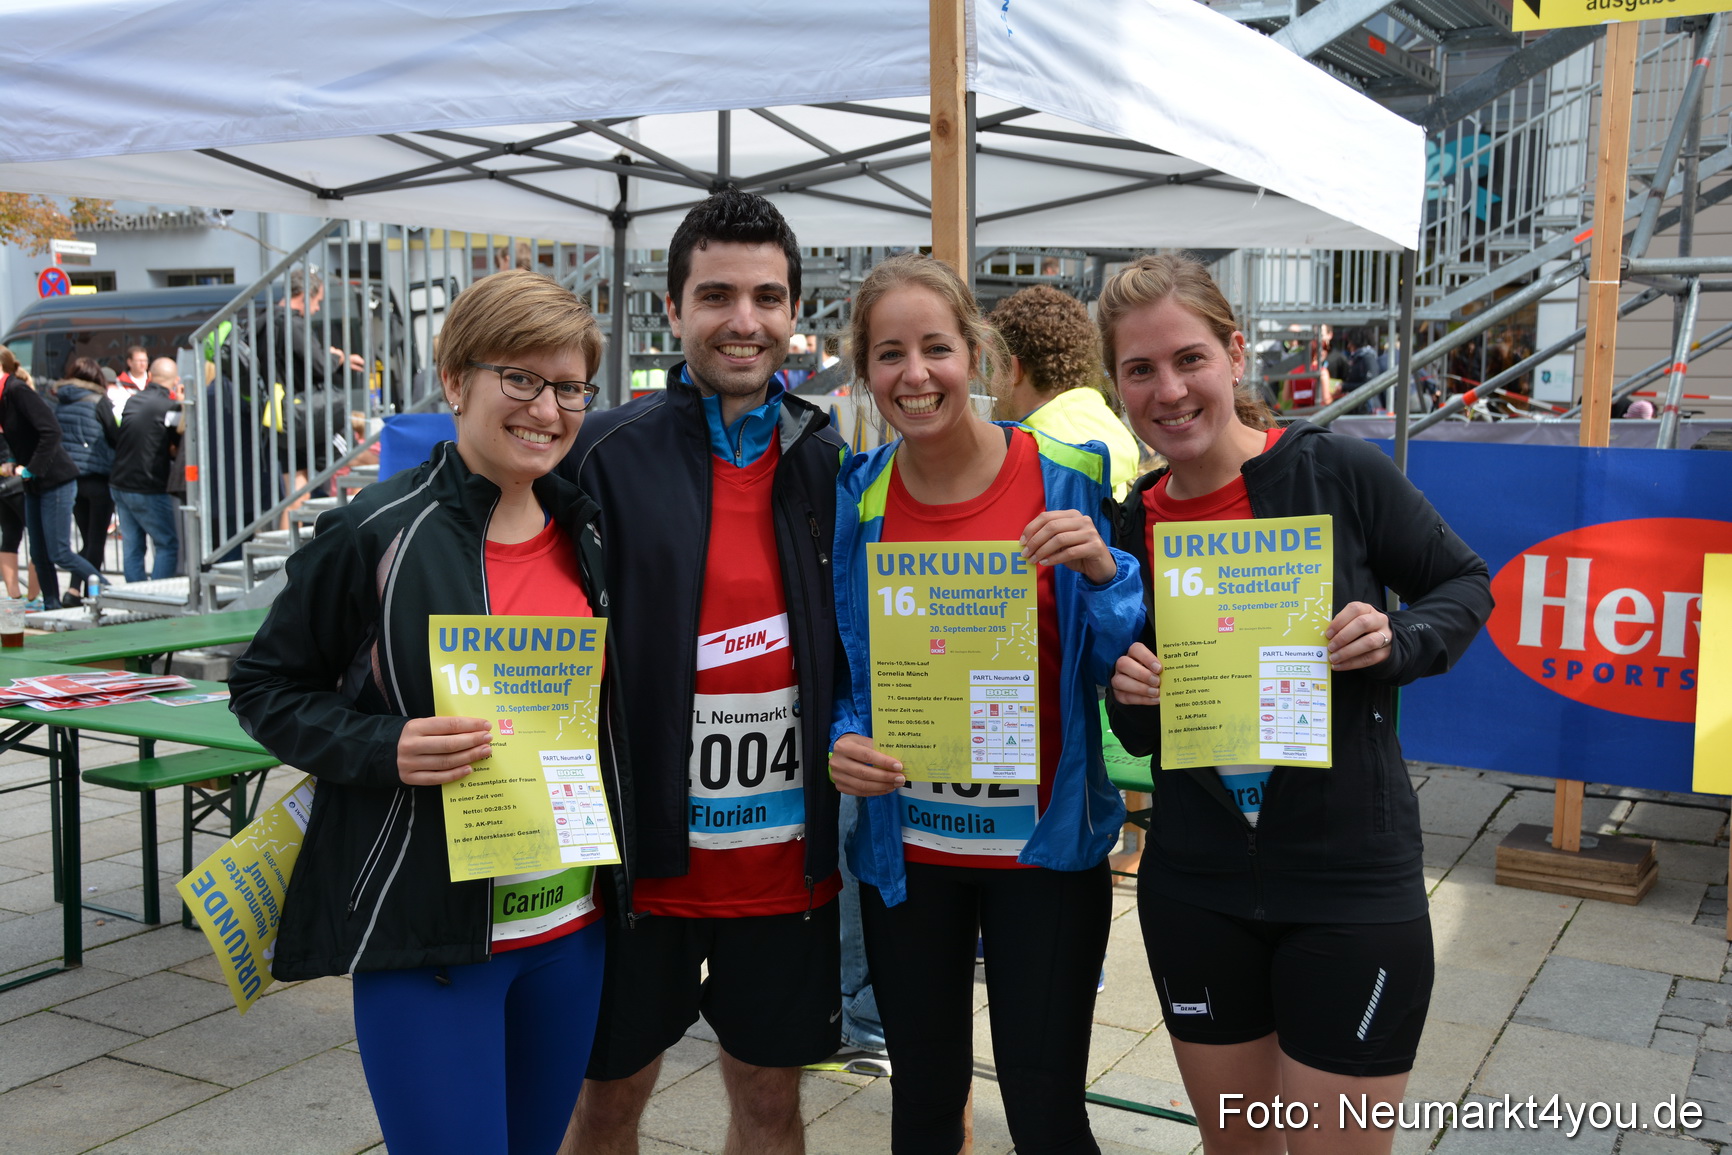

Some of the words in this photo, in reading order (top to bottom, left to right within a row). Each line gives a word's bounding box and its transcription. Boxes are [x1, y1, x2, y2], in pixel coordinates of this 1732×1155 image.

[1586, 0, 1676, 11] ausg
[1164, 527, 1322, 558] URKUNDE
[877, 552, 1028, 576] URKUNDE
[1163, 567, 1214, 597] 16.
[1218, 562, 1322, 578] Neumarkter
[1218, 577, 1301, 594] Stadtlauf
[877, 586, 926, 616] 16.
[930, 586, 1028, 599] Neumarkter
[930, 602, 1008, 618] Stadtlauf
[1232, 602, 1278, 612] September
[1517, 554, 1703, 658] Her
[439, 628, 597, 652] URKUNDE
[724, 630, 767, 654] DEHN
[943, 626, 986, 634] September
[440, 663, 490, 695] 16.
[494, 663, 593, 677] Neumarkter
[1542, 658, 1696, 690] SPORTS
[494, 679, 572, 696] Stadtlauf
[509, 704, 550, 714] September
[712, 706, 787, 724] Neumarkt
[689, 727, 800, 790] 004
[468, 779, 507, 787] Gesamtplatz
[484, 805, 511, 813] 00:28:35
[692, 803, 767, 827] Florian
[908, 804, 995, 834] Cornelia
[474, 832, 516, 841] Altersklasse:
[263, 852, 277, 869] 2015
[274, 868, 288, 895] tember
[220, 856, 268, 940] Neumarkter
[242, 861, 281, 928] Stadtlauf
[503, 886, 563, 916] Carina
[190, 871, 261, 1000] URKUNDE
